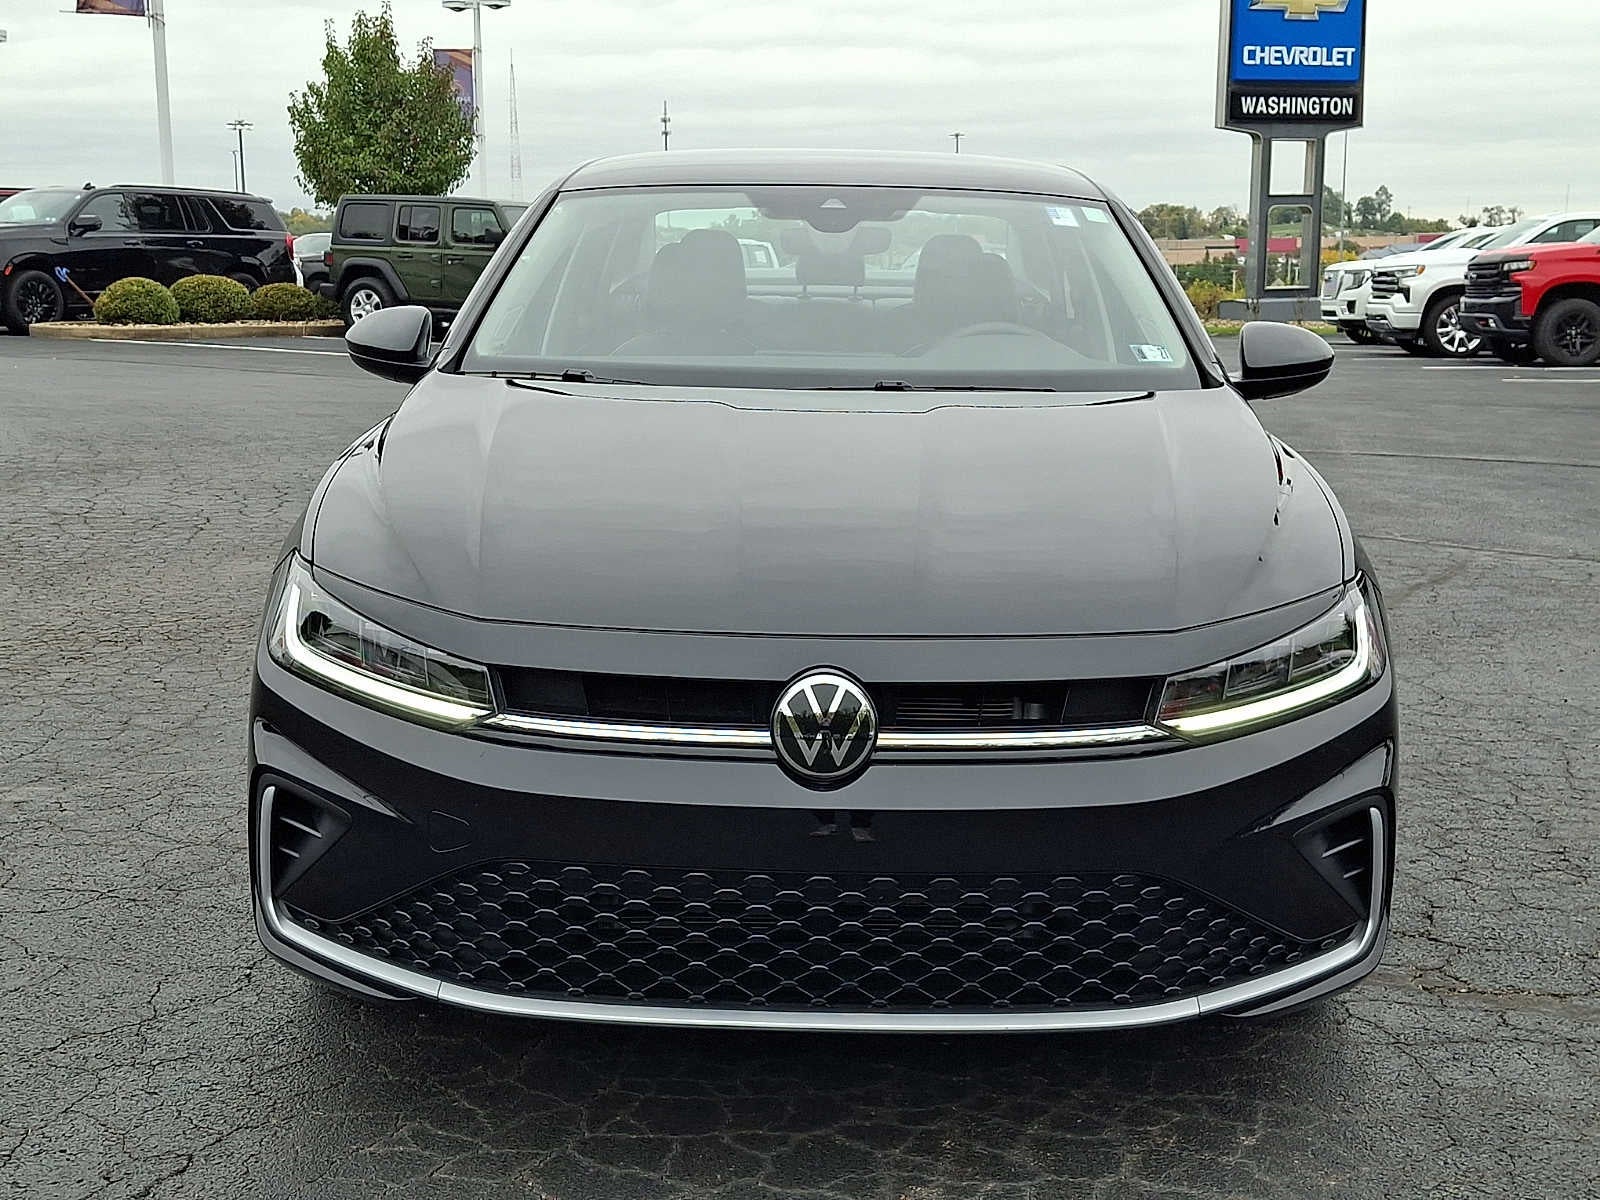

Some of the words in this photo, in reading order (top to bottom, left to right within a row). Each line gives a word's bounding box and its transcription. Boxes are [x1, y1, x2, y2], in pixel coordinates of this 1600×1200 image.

[1243, 45, 1355, 66] CHEVROLET
[1241, 96, 1353, 115] WASHINGTON
[773, 673, 876, 776] VW
